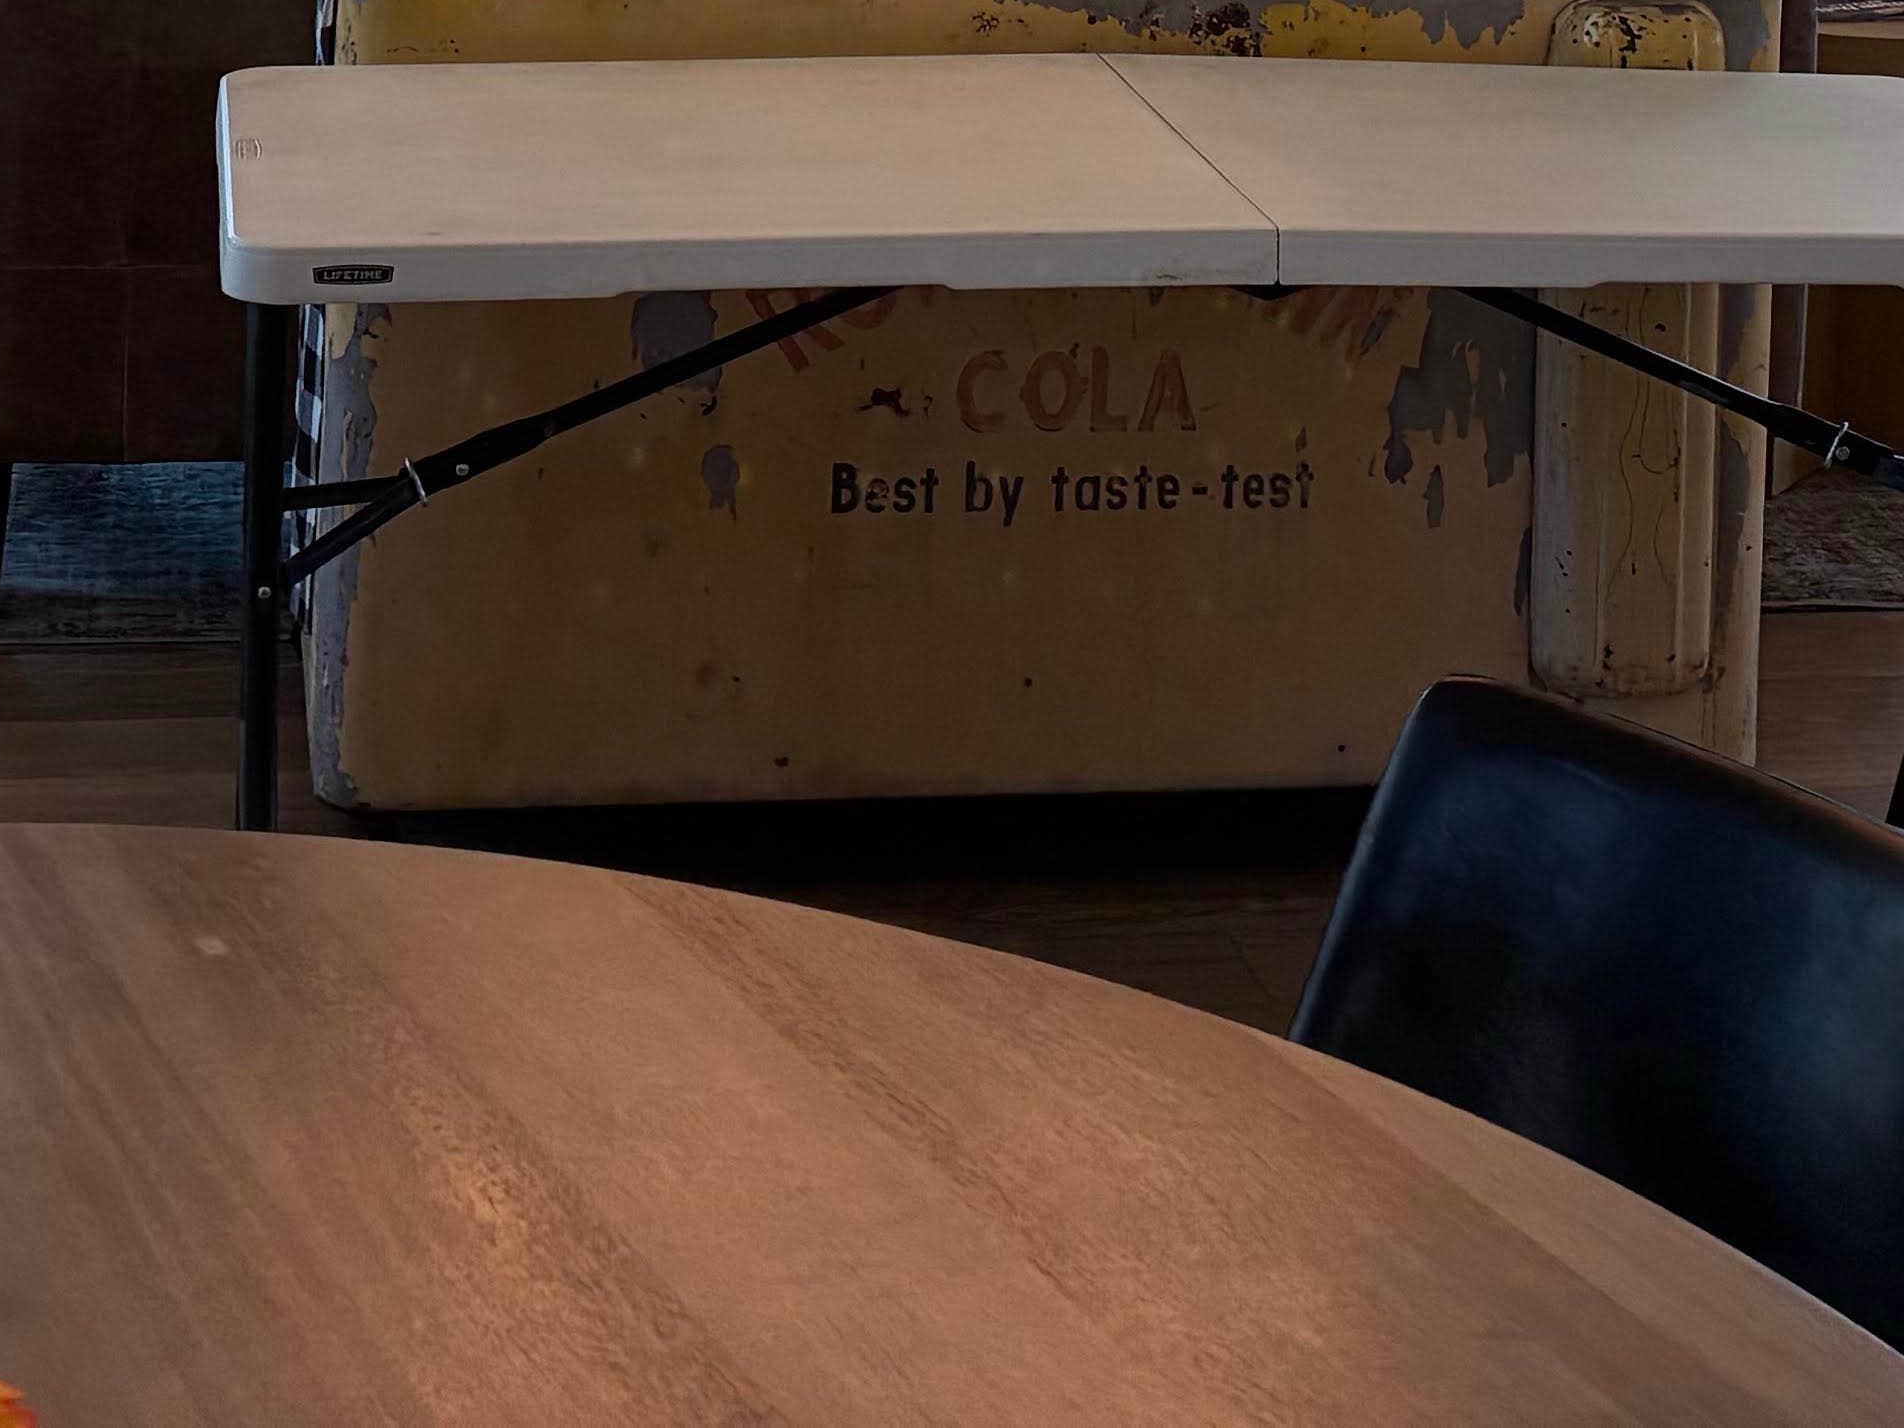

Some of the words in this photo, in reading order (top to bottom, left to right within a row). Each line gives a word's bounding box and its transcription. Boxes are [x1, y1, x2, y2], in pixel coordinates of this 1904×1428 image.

[955, 345, 1197, 434] COLA
[830, 461, 939, 514] Best
[964, 459, 1024, 527] by
[1052, 461, 1314, 513] taste-test
